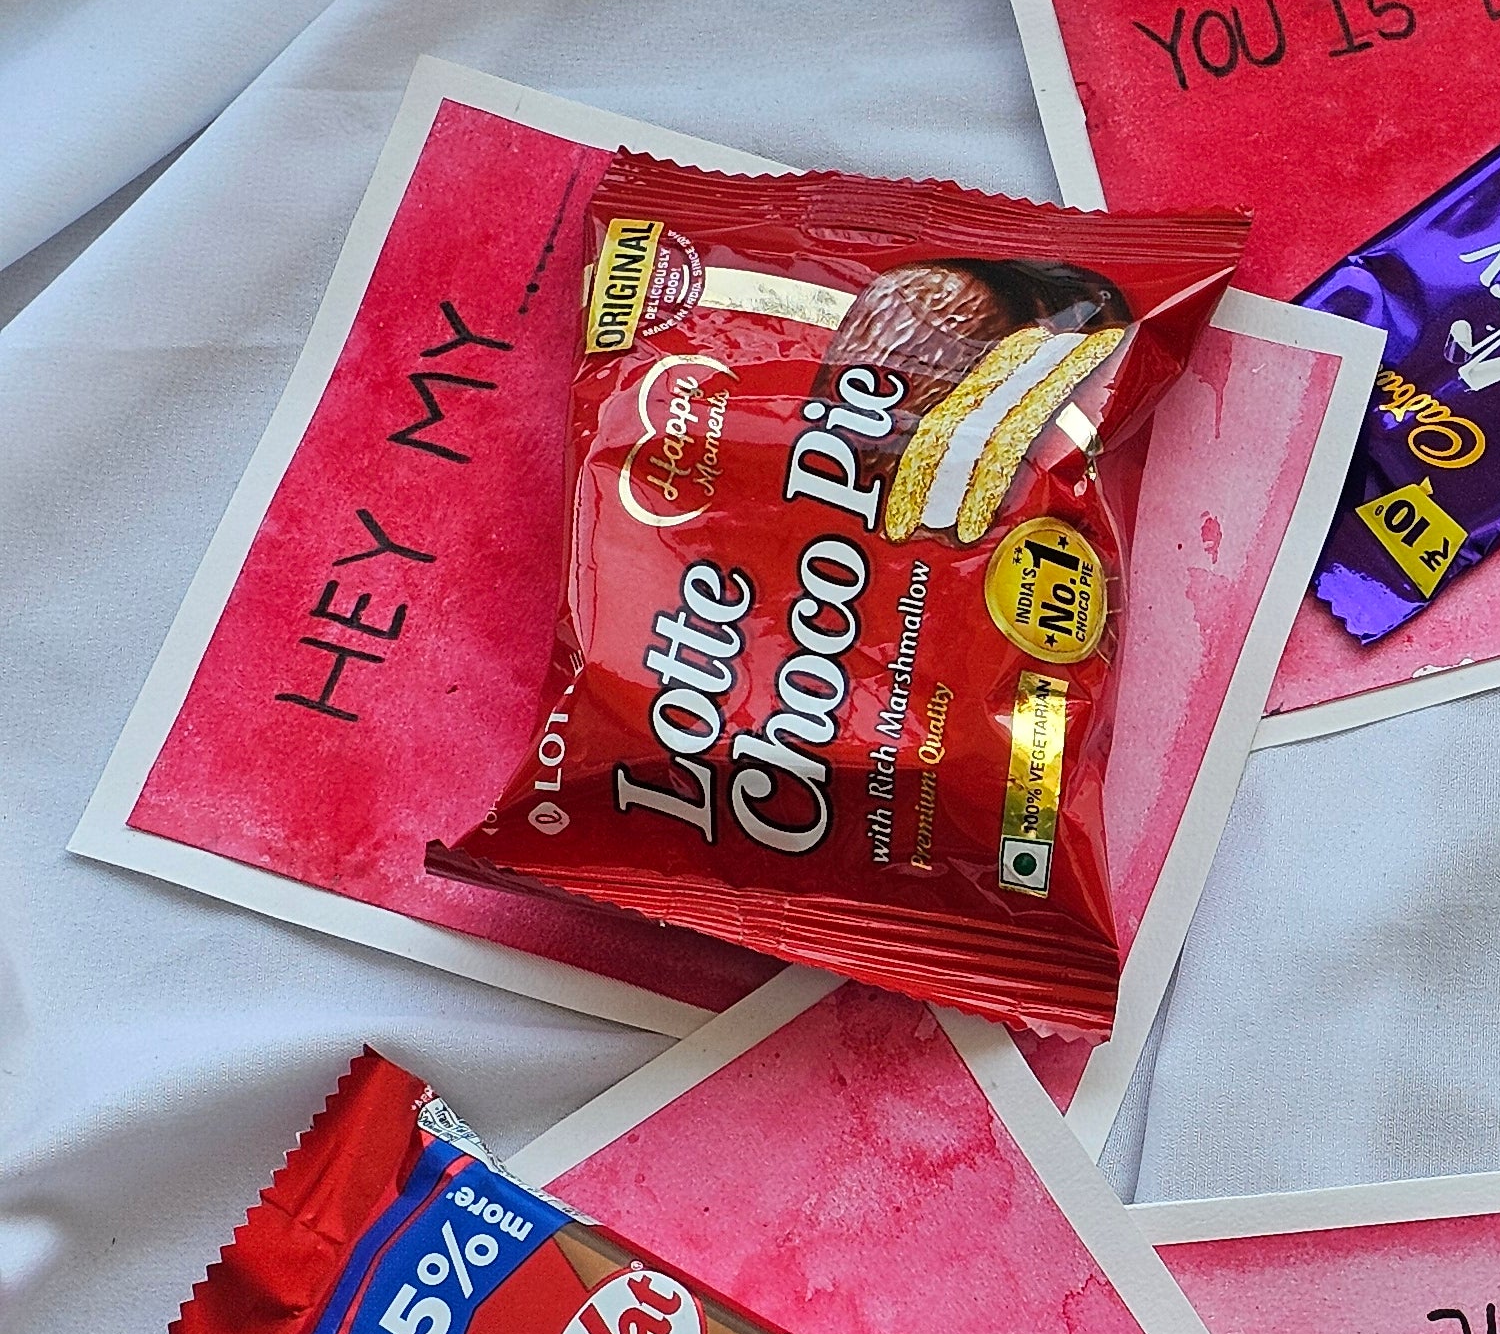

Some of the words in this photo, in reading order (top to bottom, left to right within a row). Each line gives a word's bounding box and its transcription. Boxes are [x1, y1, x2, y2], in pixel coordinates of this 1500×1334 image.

[595, 222, 655, 348] ORIGINAL
[645, 247, 671, 319] DELICIOUSLY
[647, 376, 700, 501] Happy
[692, 387, 730, 497] Moments
[785, 367, 905, 529] Pie
[1376, 364, 1486, 469] Cadbu
[274, 508, 437, 722] HEY
[387, 300, 514, 465] MY
[1015, 567, 1037, 624] INDIA'S
[1075, 589, 1091, 643] CHOCO
[1080, 562, 1094, 587] PIE
[731, 540, 867, 853] Choco
[876, 561, 931, 738] Marshmallow
[534, 650, 585, 792] LOTE
[617, 562, 751, 843] Lotte
[918, 681, 954, 764] Quality
[1029, 679, 1051, 781] VEGETARIAN
[868, 745, 897, 800] Rich
[911, 771, 937, 870] Premium
[1024, 787, 1043, 834] 100%
[867, 808, 893, 863] with
